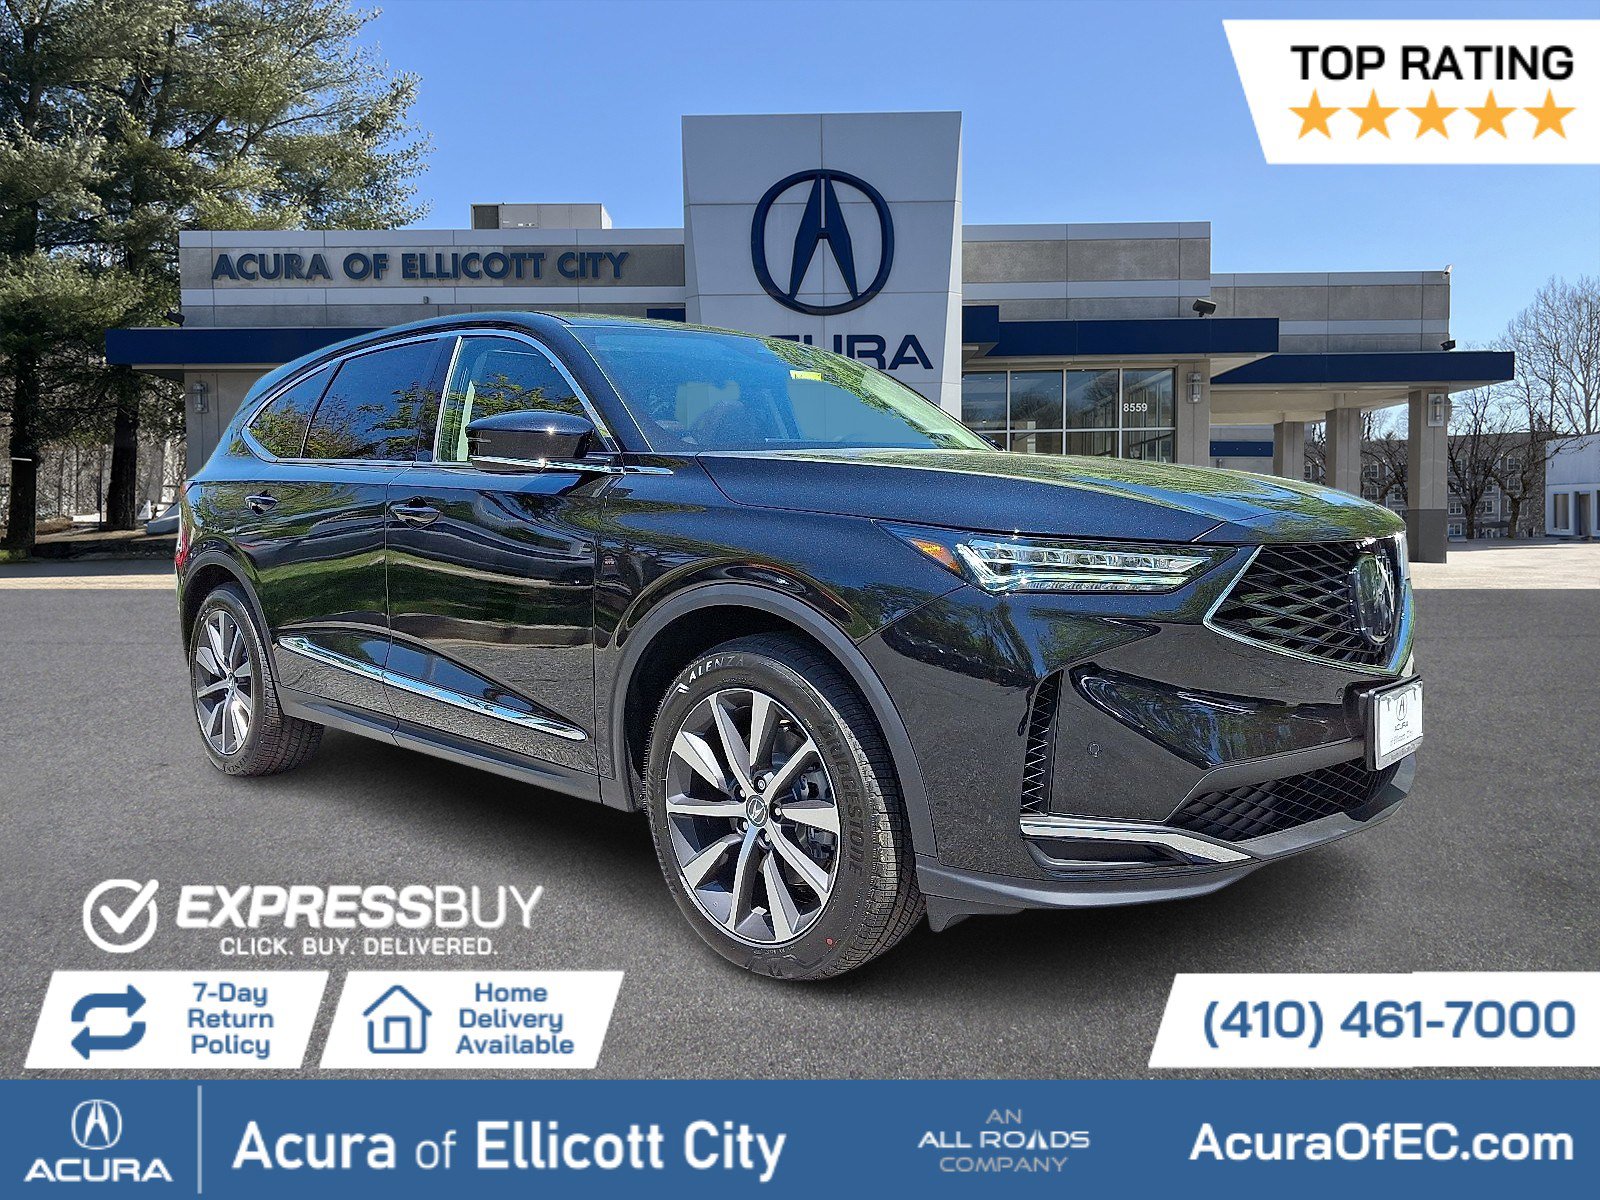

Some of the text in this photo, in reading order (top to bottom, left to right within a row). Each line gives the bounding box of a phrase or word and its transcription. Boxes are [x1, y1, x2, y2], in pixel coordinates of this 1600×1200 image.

[211, 252, 630, 280] ACURA OF ELLICOTT CITY
[1123, 402, 1148, 413] 8559
[689, 654, 744, 684] ALENZA
